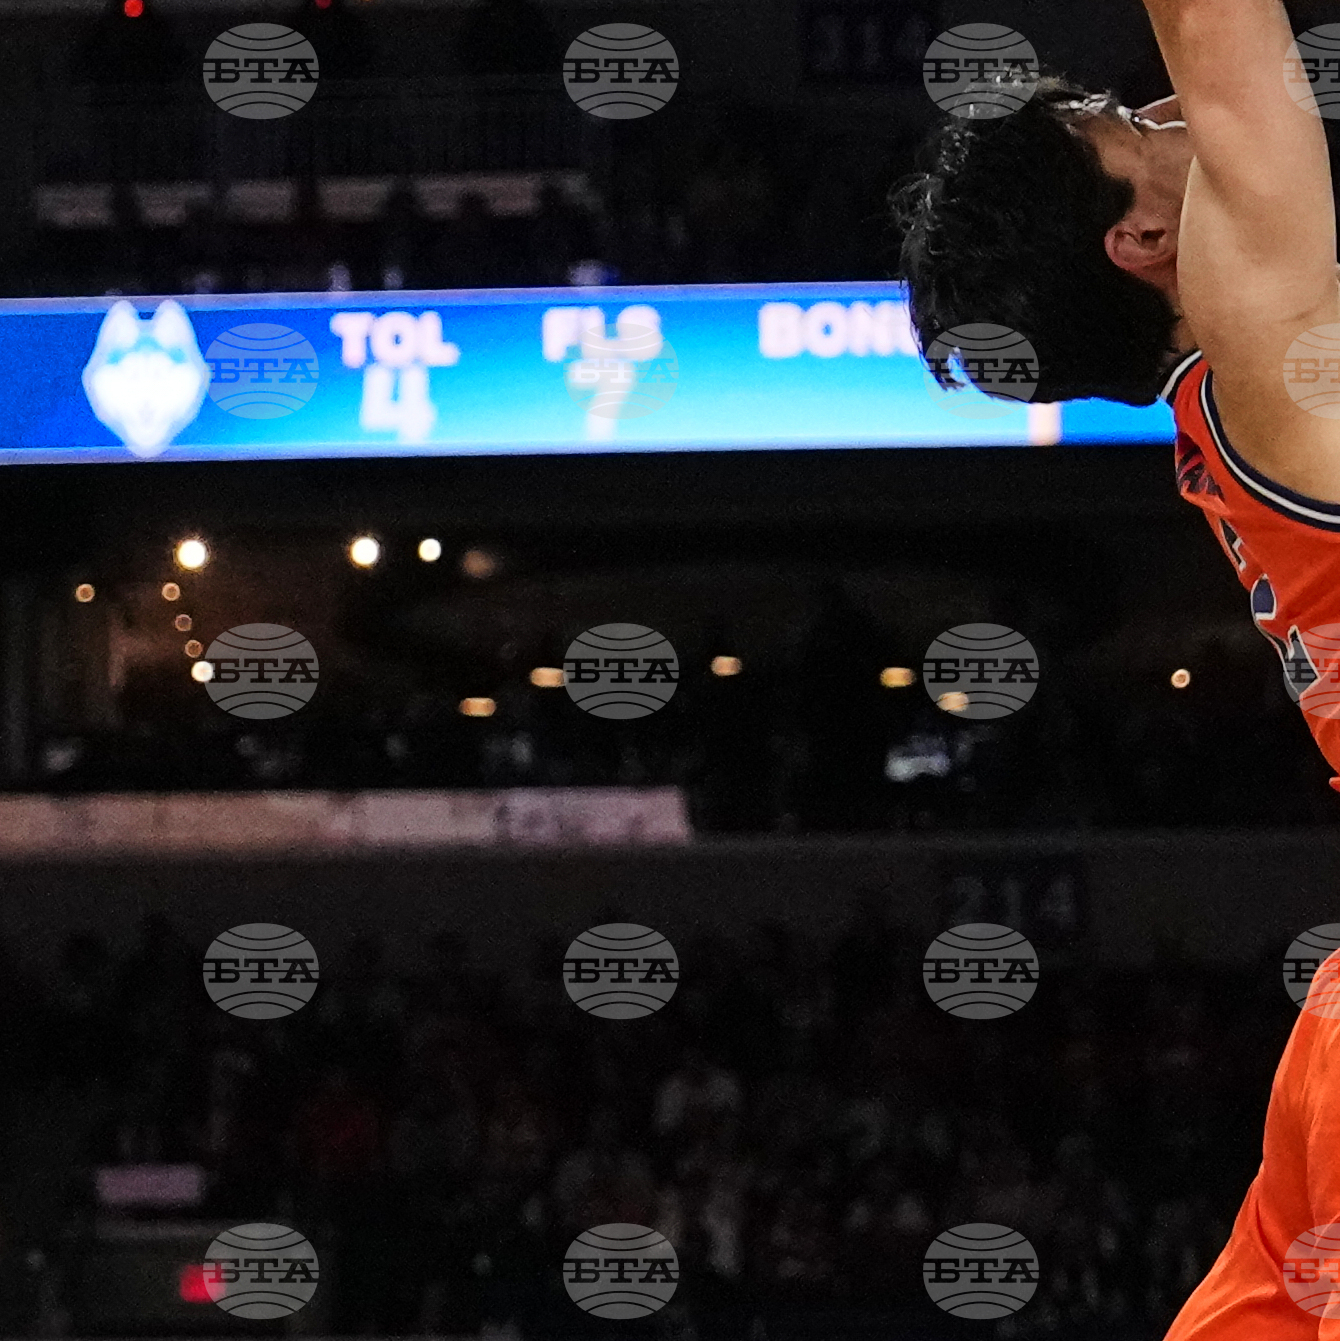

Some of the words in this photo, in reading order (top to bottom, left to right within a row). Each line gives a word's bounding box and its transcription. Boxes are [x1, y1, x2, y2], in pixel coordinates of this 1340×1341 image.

[330, 311, 461, 368] TOL
[542, 303, 663, 362] FLS
[359, 360, 437, 445] 4
[566, 357, 637, 441] 7
